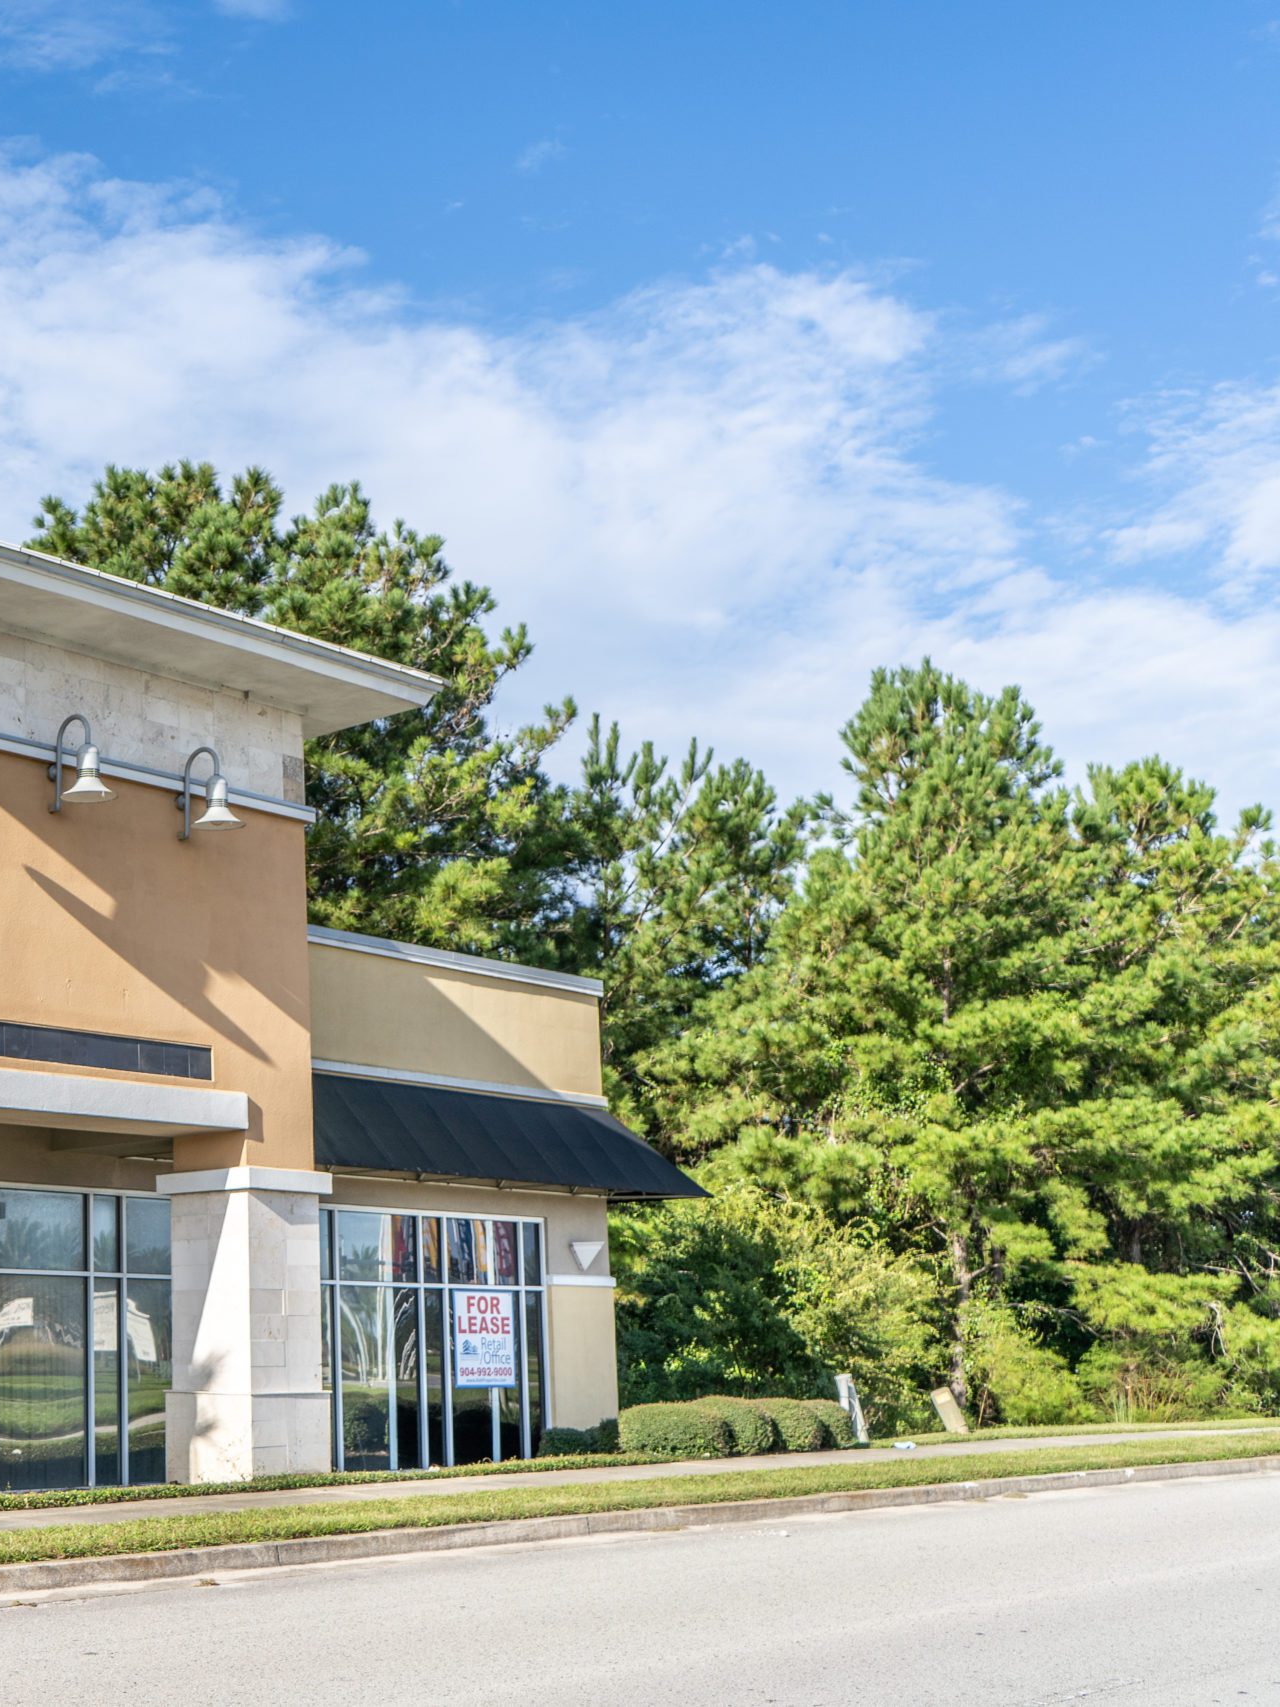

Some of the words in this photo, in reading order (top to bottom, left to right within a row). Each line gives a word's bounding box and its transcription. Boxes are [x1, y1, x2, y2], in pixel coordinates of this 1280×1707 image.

[466, 1295, 500, 1314] FOR
[458, 1316, 510, 1334] LEASE
[481, 1337, 506, 1351] Retail
[460, 1367, 512, 1377] 904-992-9000
